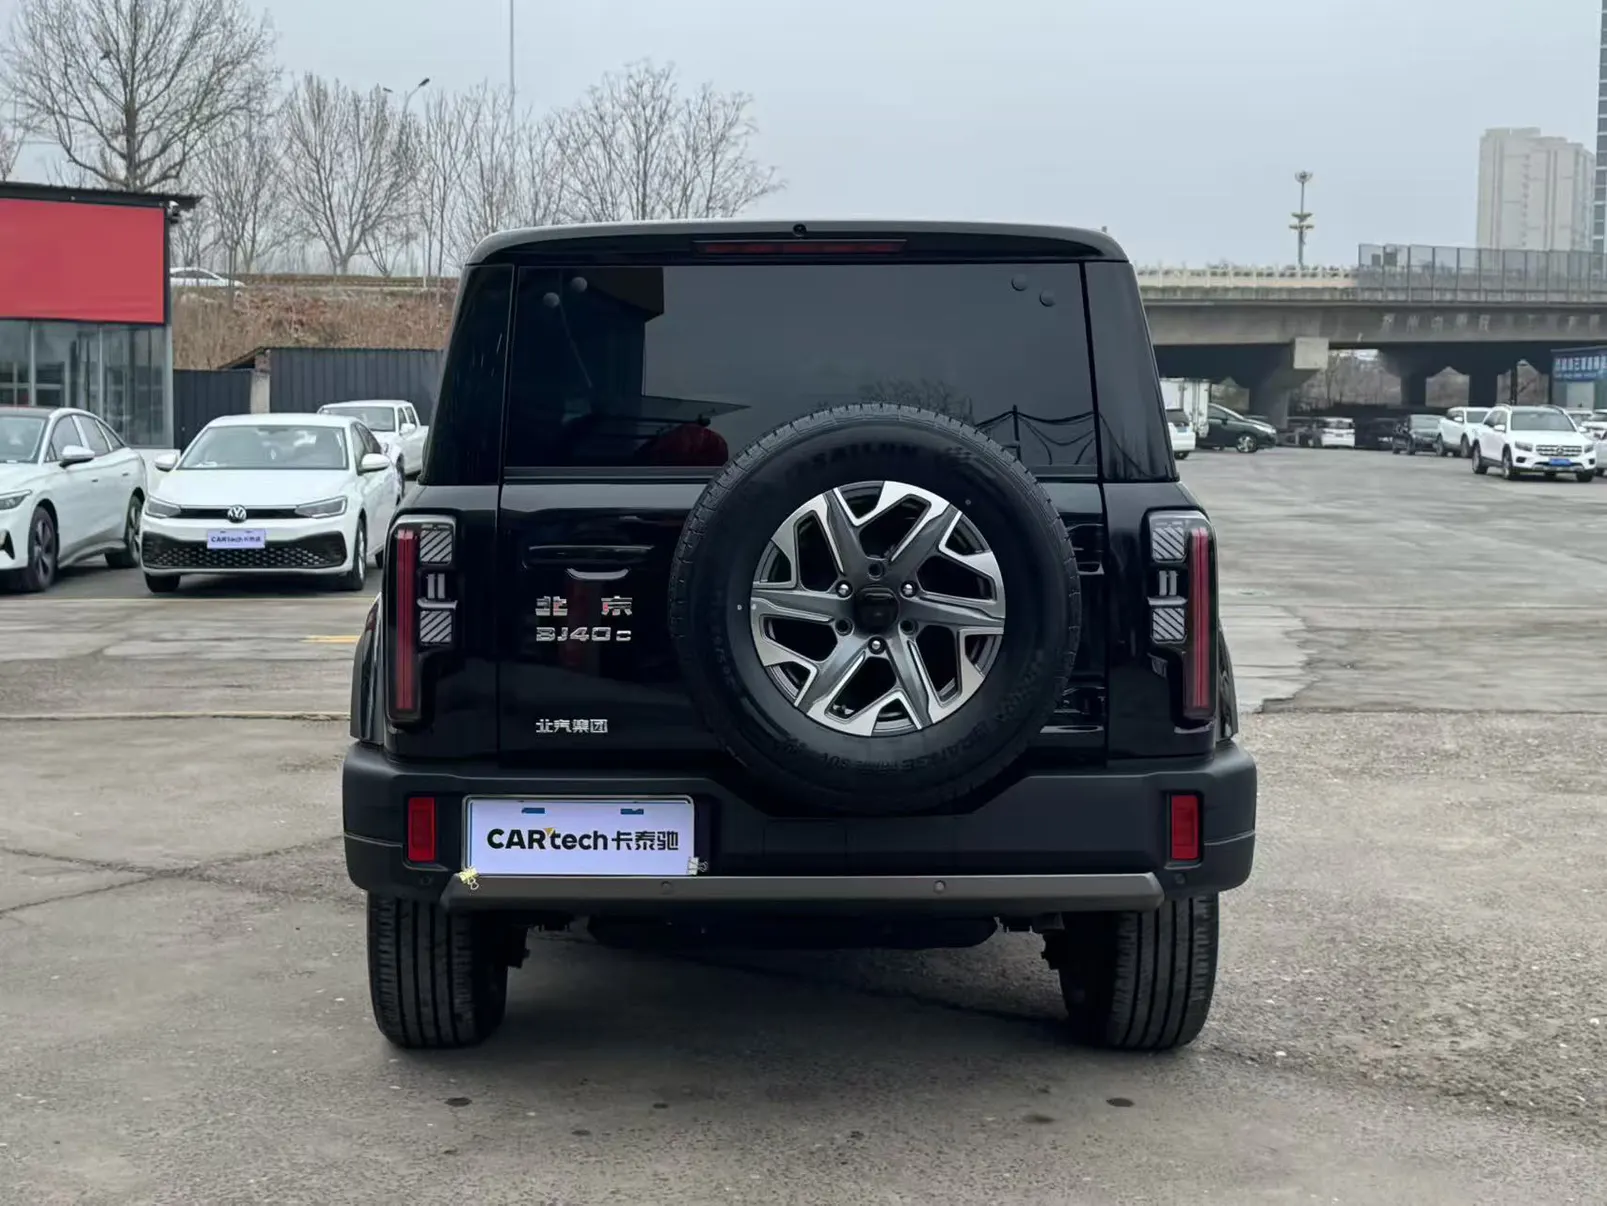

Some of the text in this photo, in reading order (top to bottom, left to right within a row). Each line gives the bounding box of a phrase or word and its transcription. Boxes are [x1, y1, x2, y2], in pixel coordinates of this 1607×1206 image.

[535, 596, 633, 616] 北京
[535, 719, 608, 733] 北汽集团
[487, 828, 679, 851] CARtech 卡泰驰
